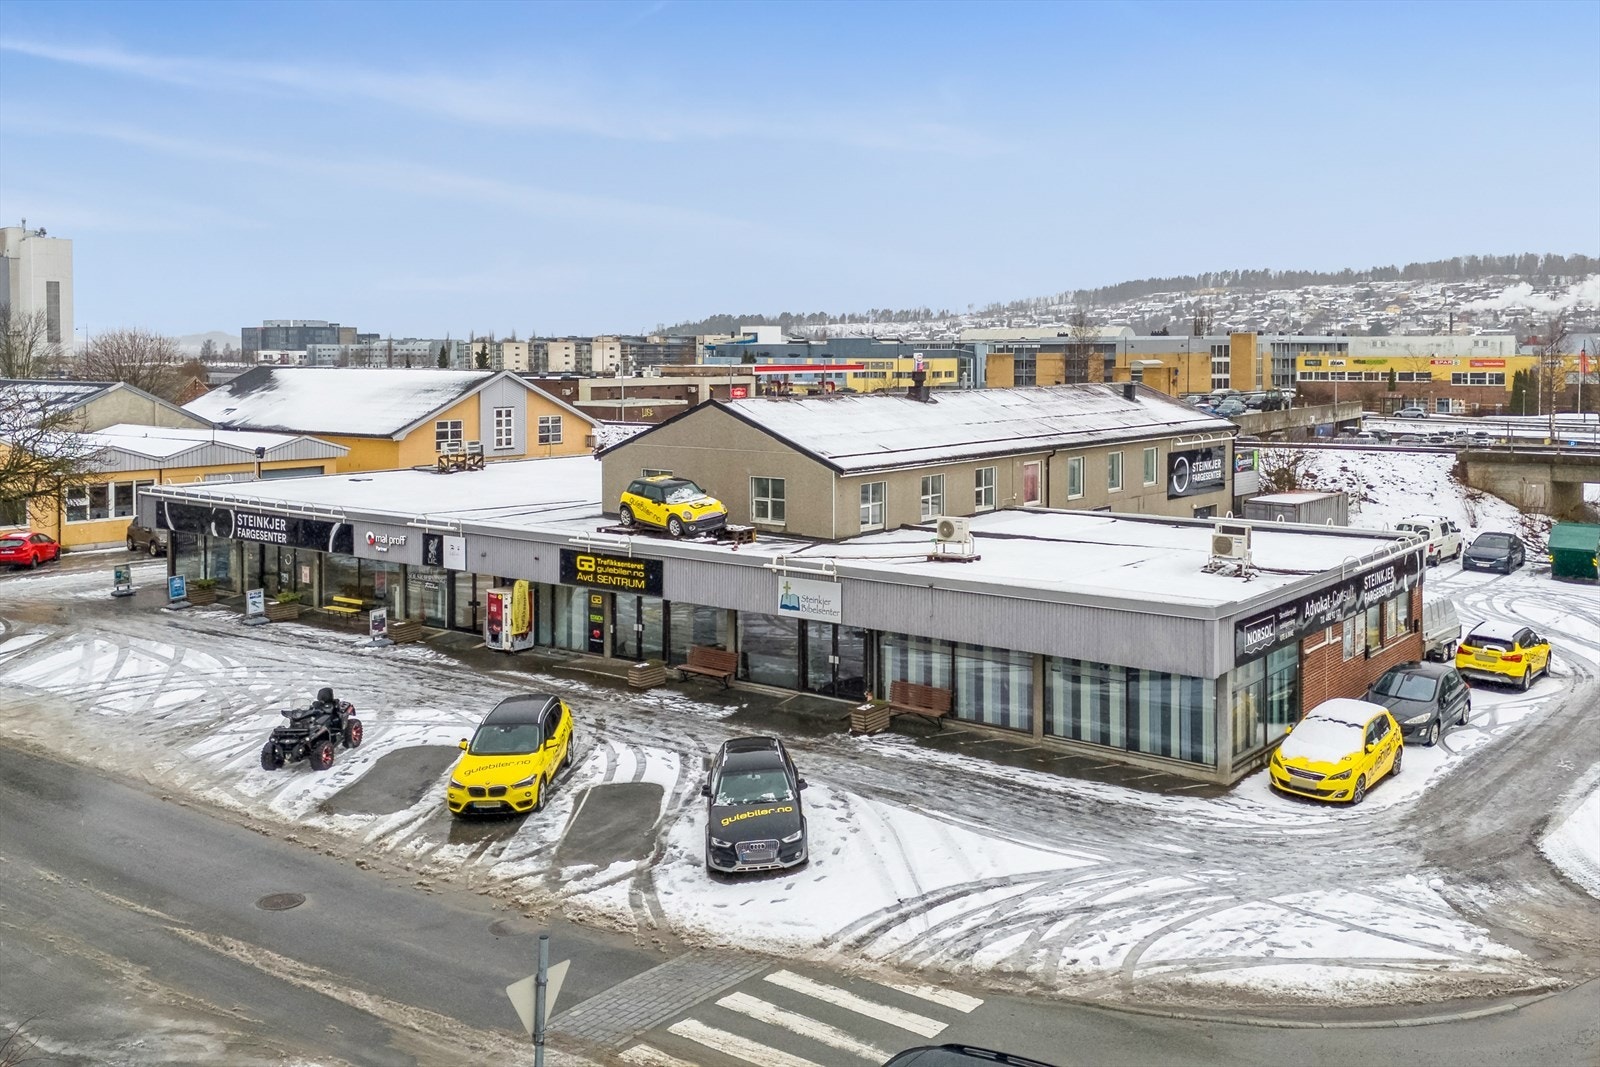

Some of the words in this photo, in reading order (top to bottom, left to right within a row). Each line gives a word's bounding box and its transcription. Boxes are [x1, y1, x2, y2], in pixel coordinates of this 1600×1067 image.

[1191, 459, 1222, 473] STEINKJER
[1191, 470, 1222, 483] FARGESENTER
[236, 513, 287, 532] STEINKJER
[236, 527, 288, 544] FARGESENTER
[375, 533, 388, 544] mal
[388, 535, 406, 547] proff
[596, 566, 645, 578] gulebiler.no
[597, 558, 644, 570] Trafikksenteret
[576, 572, 595, 583] Avd.
[597, 574, 645, 589] SENTRUM
[1363, 566, 1395, 590] STEINKJER
[800, 594, 832, 609] Steinkjer
[1364, 581, 1395, 605] FARGESENTER
[800, 603, 841, 617] Bibelsenter
[1247, 623, 1273, 646] NORSOL
[463, 759, 531, 776] gulebiler.no
[720, 806, 793, 827] gulebiler.no
